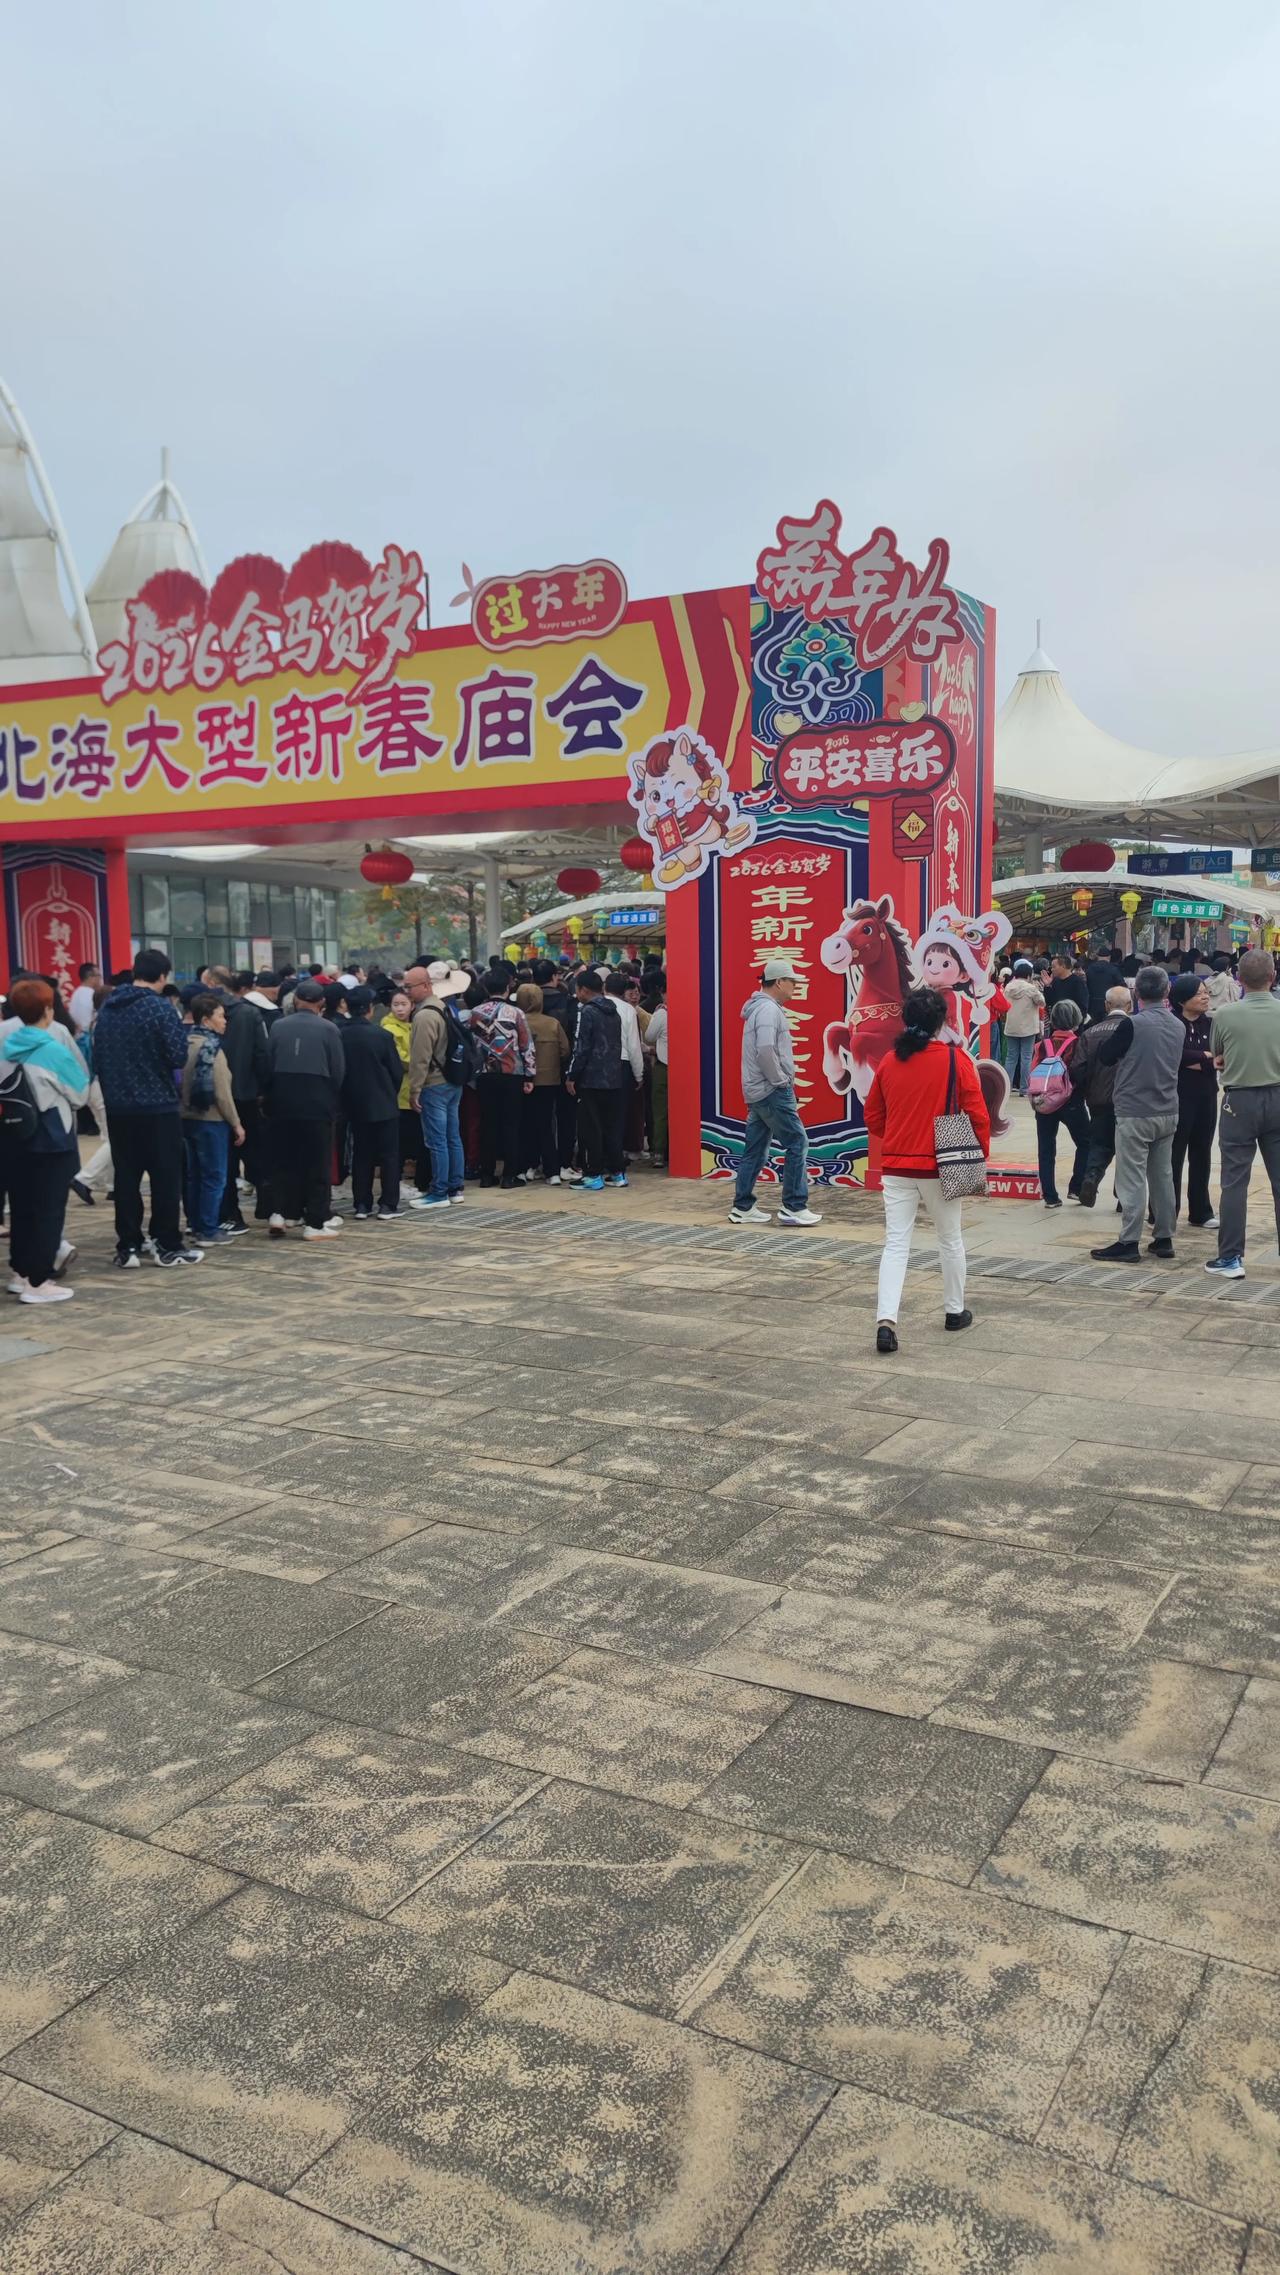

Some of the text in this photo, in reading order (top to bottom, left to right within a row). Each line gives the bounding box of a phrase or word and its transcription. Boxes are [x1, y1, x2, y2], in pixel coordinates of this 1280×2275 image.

[485, 570, 605, 639] 过大年
[762, 507, 958, 663] 新年好
[538, 614, 597, 630] HAPPY NEW YEAR
[0, 657, 645, 801] 北海大型新春庙会
[784, 729, 944, 793] 平安喜乐
[825, 734, 850, 751] 2026
[944, 819, 960, 907] 新春
[1157, 903, 1205, 915] 绿色通道
